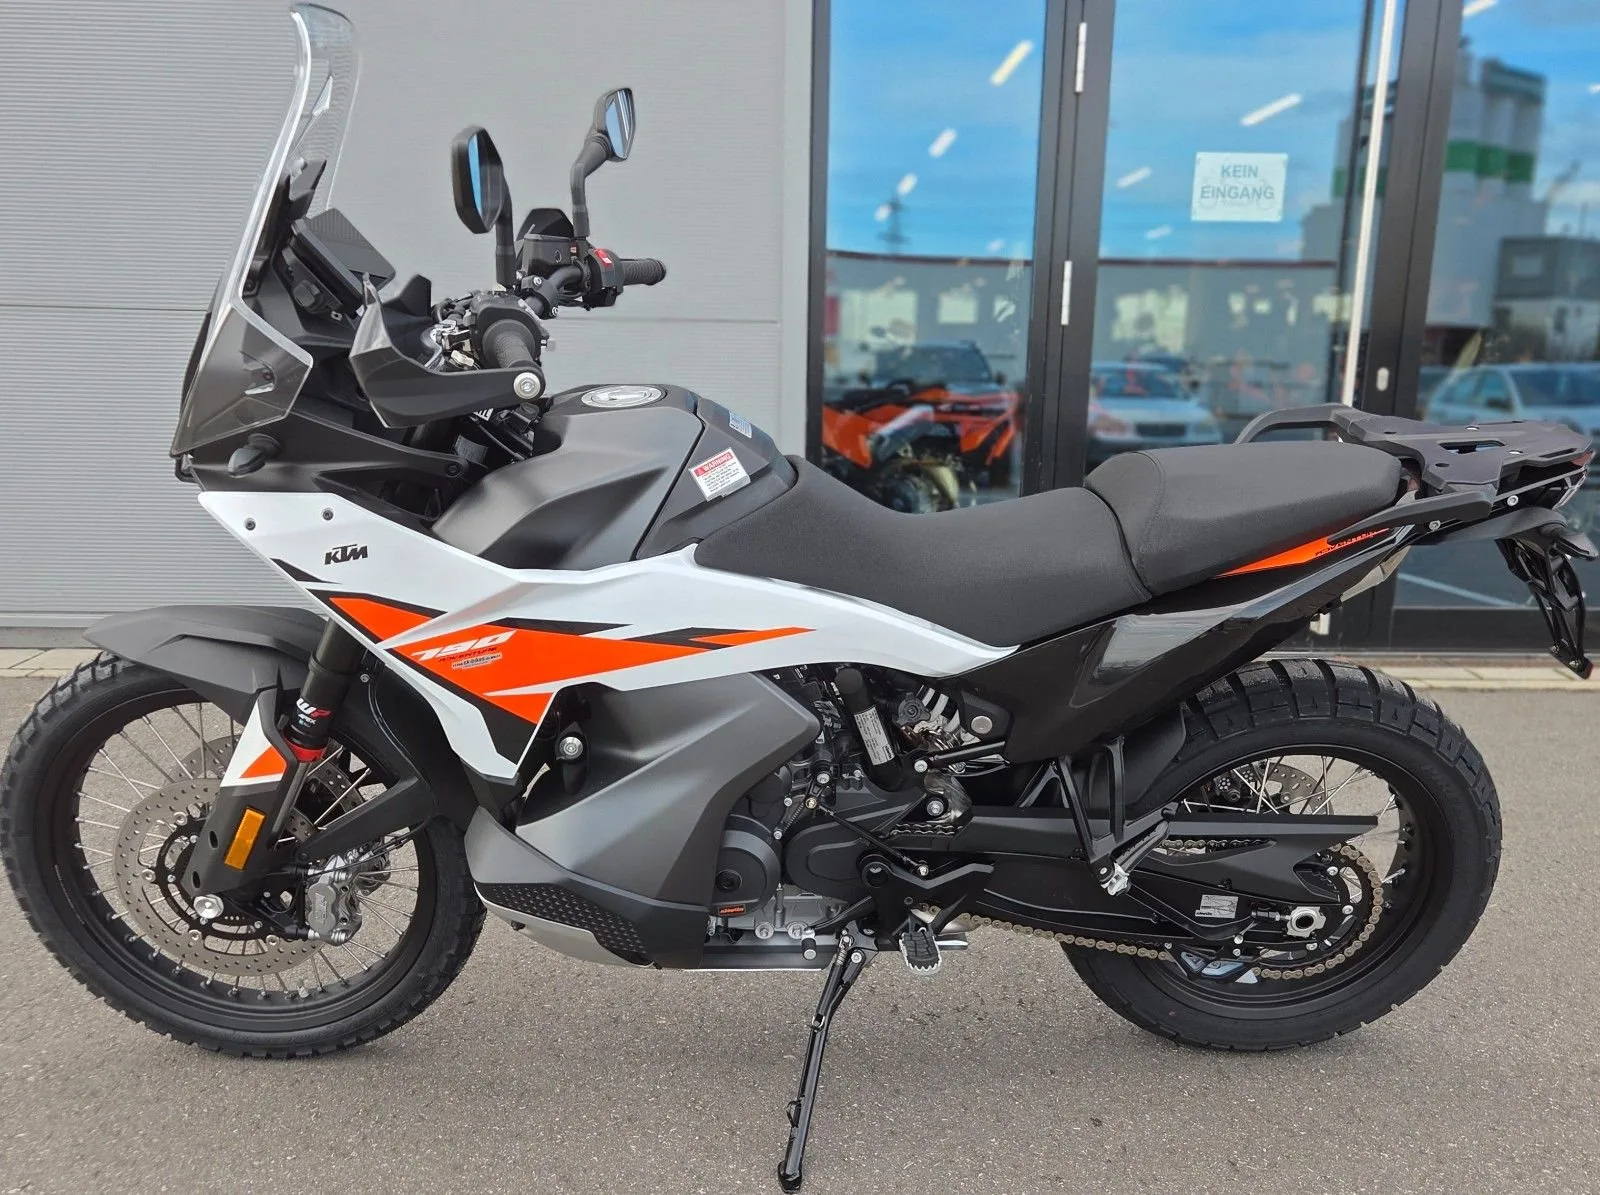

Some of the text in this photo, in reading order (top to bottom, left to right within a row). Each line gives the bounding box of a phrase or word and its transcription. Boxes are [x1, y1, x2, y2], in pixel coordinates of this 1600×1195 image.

[1221, 163, 1259, 178] KEIN
[1200, 185, 1275, 200] EINGANG
[703, 451, 733, 472] WARNING
[324, 543, 369, 566] KTM
[411, 629, 517, 662] 790
